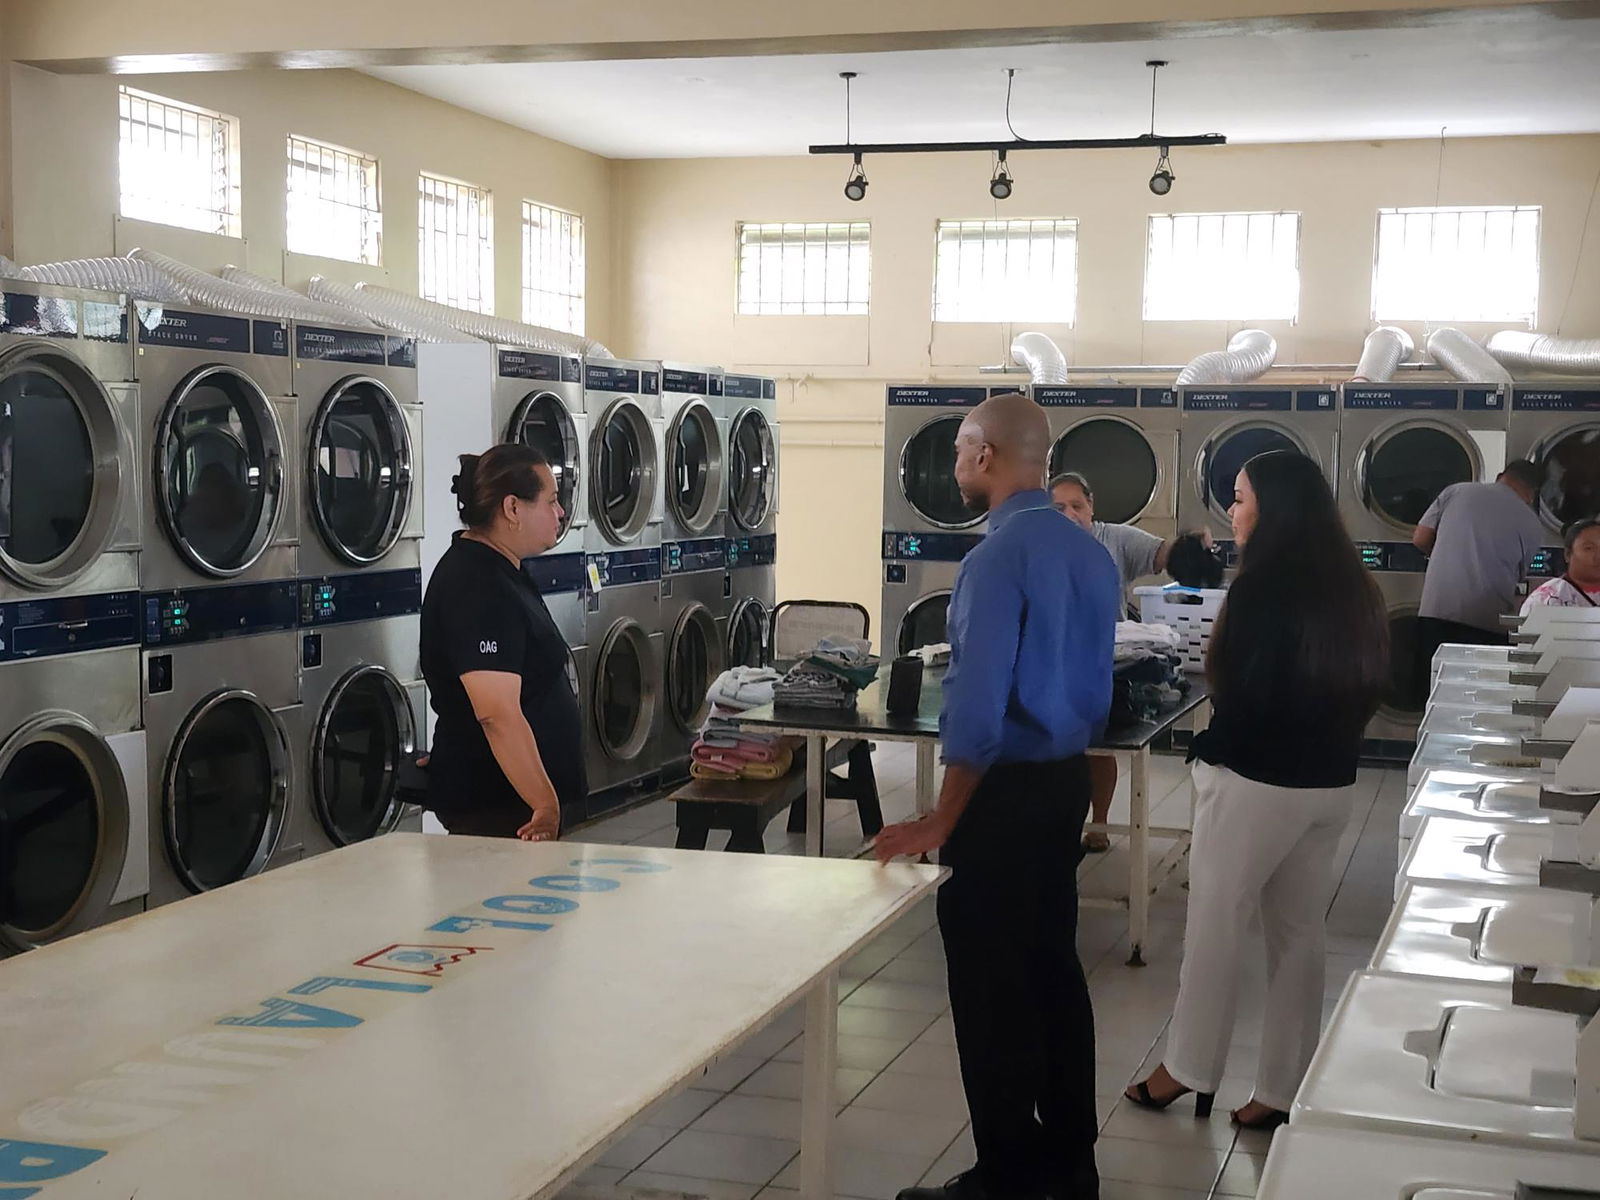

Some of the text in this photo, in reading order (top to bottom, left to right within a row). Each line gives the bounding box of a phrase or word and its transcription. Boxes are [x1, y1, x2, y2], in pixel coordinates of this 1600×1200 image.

[303, 332, 336, 344] DEXTER
[479, 639, 498, 654] OAG
[0, 858, 672, 1200] COOL LAUNDR
